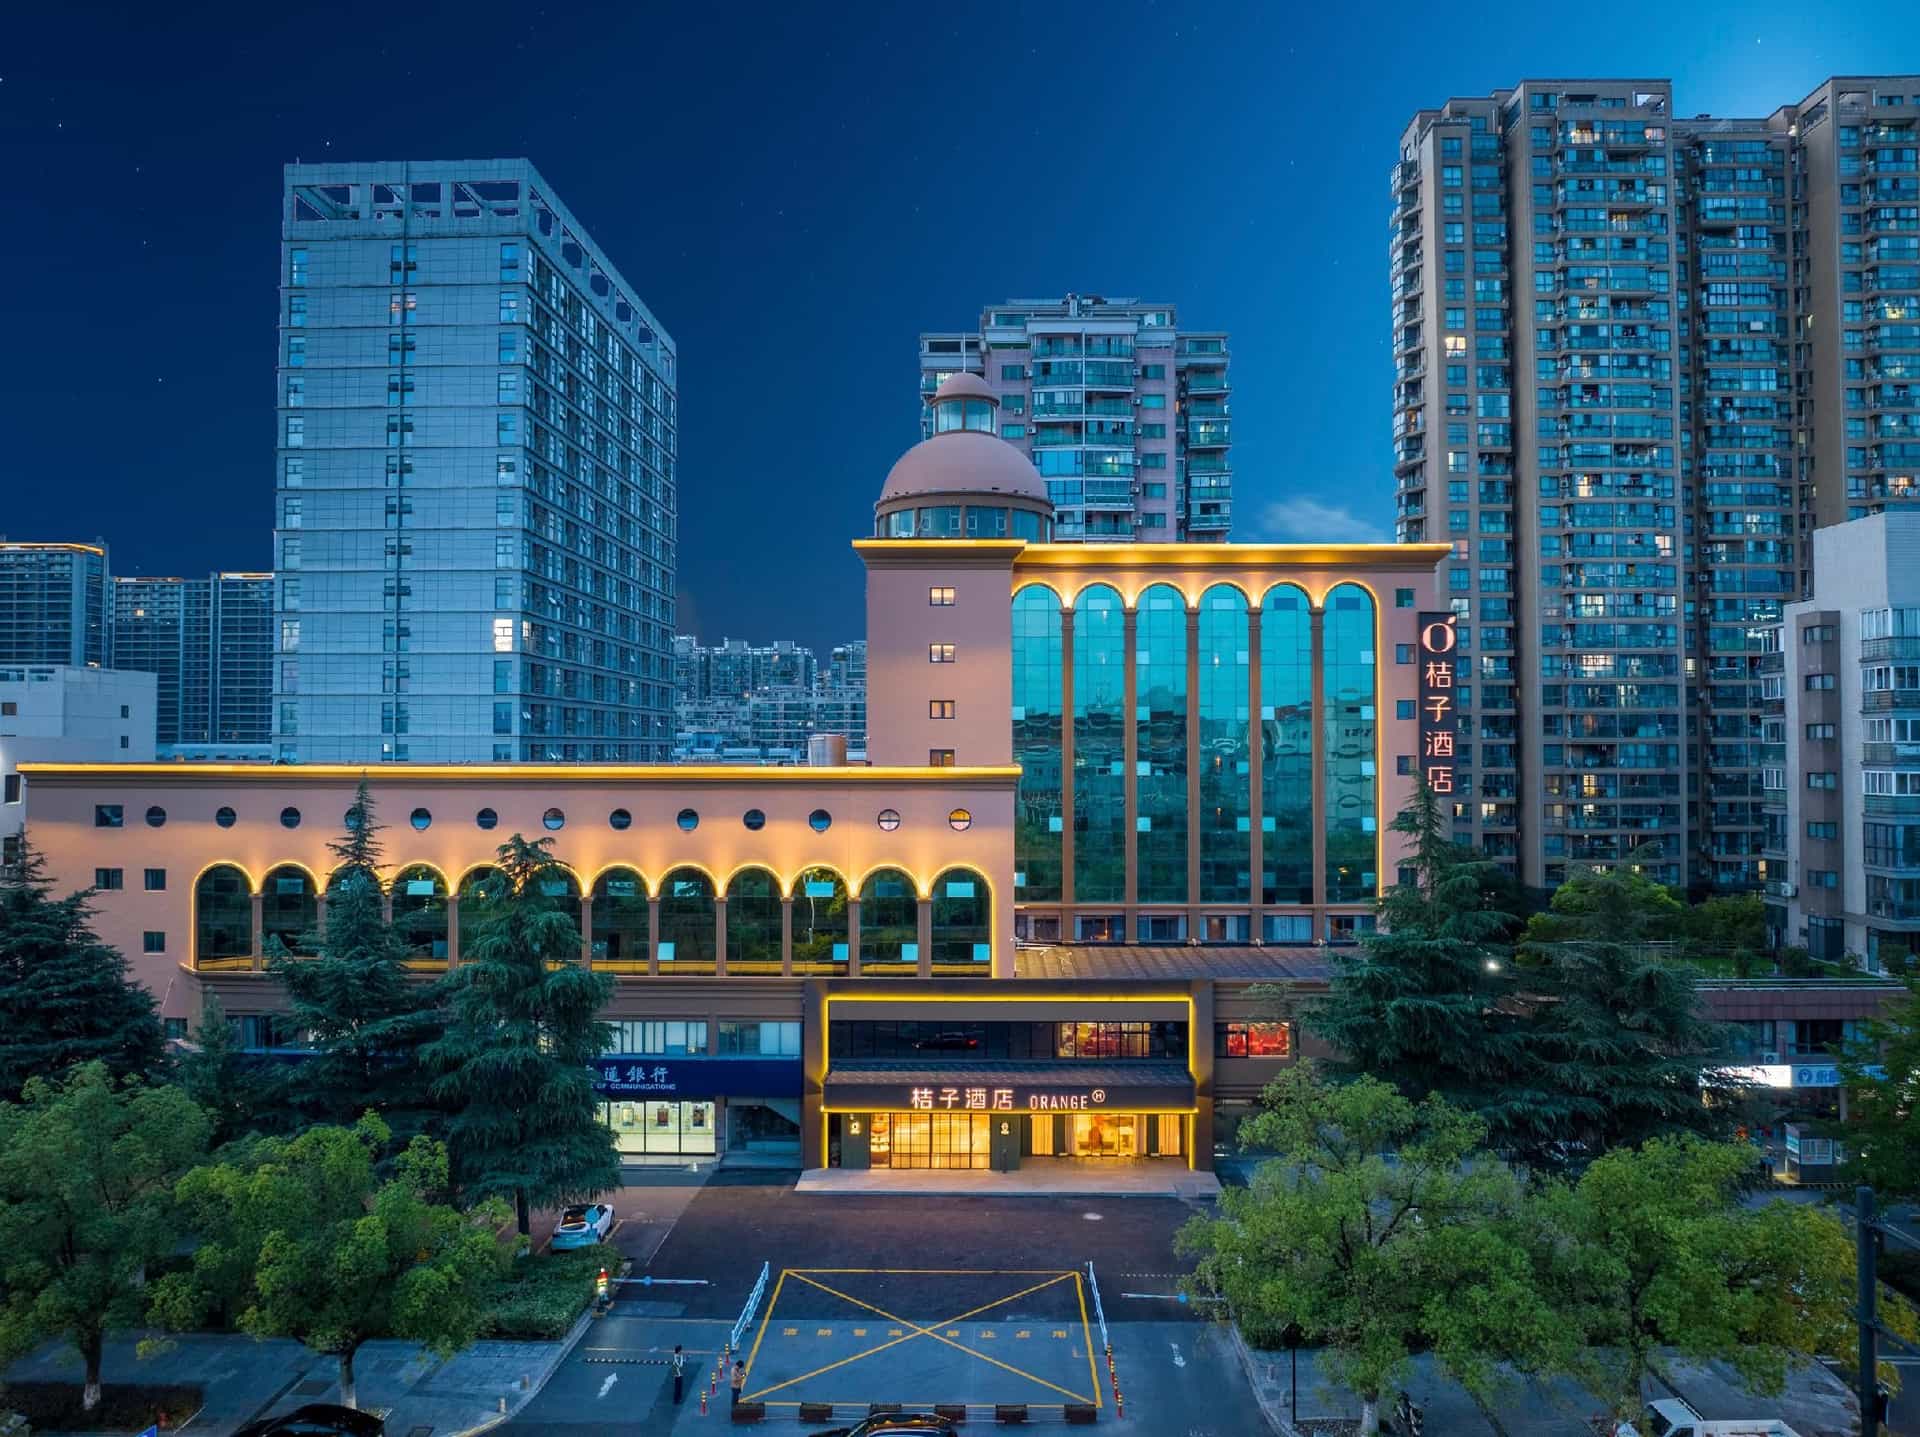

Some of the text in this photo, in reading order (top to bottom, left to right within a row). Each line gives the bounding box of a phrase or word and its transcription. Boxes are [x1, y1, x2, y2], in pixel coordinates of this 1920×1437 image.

[1424, 661, 1453, 793] 桔子酒店
[911, 1087, 1014, 1110] 桔子酒店
[1029, 1094, 1089, 1110] ORANGE
